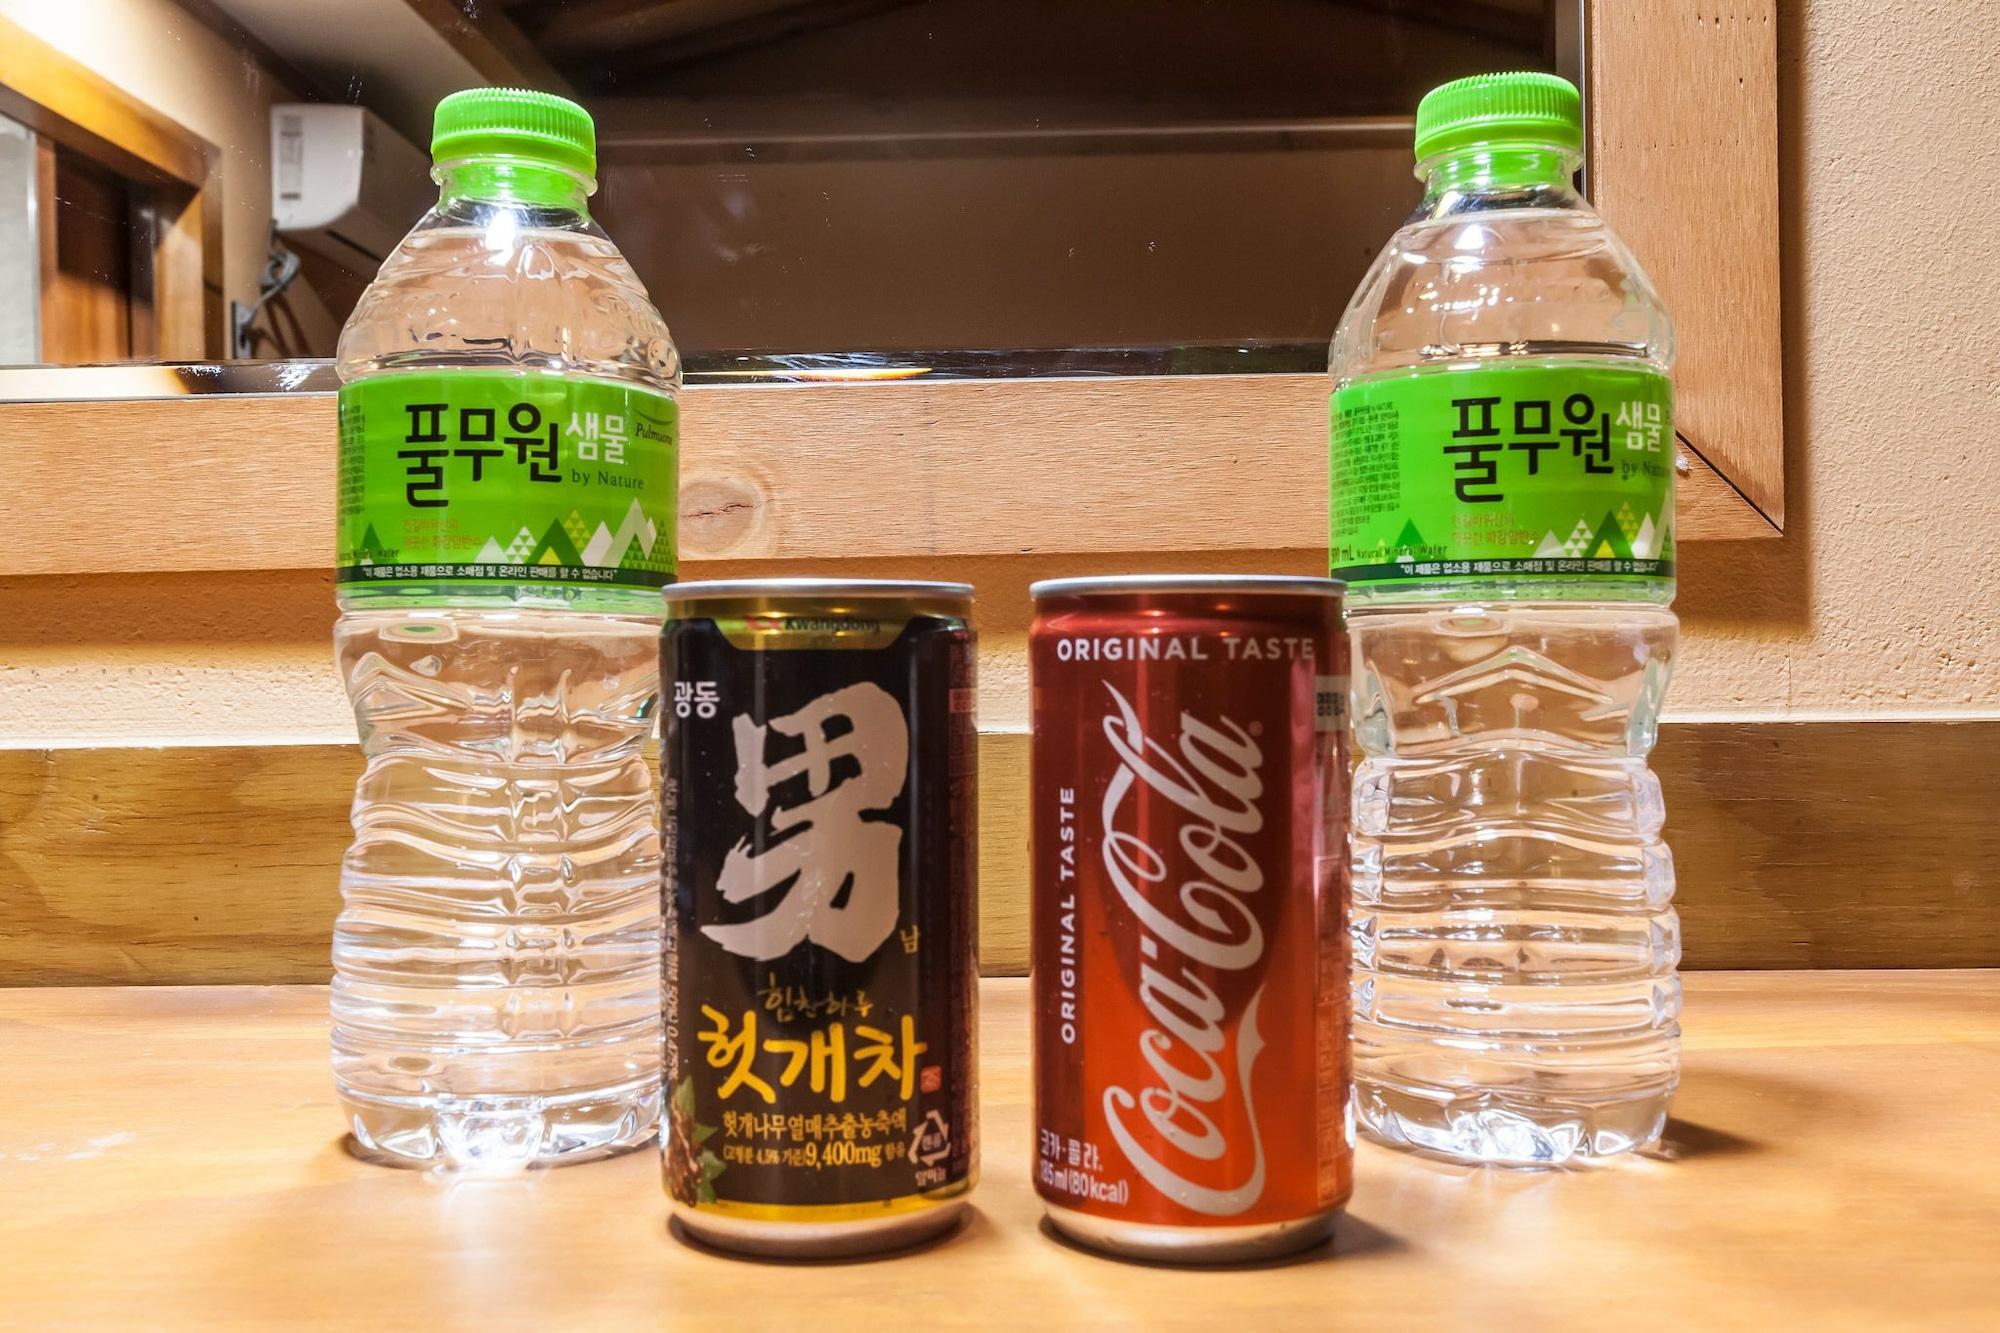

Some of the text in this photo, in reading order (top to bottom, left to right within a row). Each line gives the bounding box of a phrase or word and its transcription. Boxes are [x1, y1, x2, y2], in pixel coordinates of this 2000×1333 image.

[398, 402, 562, 508] 풀무원
[565, 412, 629, 465] 샘물
[571, 468, 644, 490] by Nature
[1443, 393, 1614, 503] 풀무원
[1615, 401, 1663, 453] 샘물
[395, 565, 418, 578] 업소용
[420, 565, 454, 577] 제품으로
[456, 565, 484, 577] 소매점
[486, 565, 496, 577] 및
[498, 565, 527, 578] 온라인
[571, 568, 580, 579] 수
[1415, 562, 1441, 575] 제품은
[1443, 561, 1471, 574] 업소용
[1473, 560, 1513, 573] 제품으로
[1515, 560, 1543, 573] 소매점
[1558, 560, 1584, 572] 온라인
[1623, 560, 1633, 572] 수
[1420, 544, 1448, 555] Water
[1056, 637, 1315, 662] ORIGINAL TASTE
[673, 680, 720, 719] 광동
[700, 681, 909, 963] 男
[1059, 787, 1077, 1045] ORIGINAL TASTE
[1102, 679, 1265, 1217] Coca-Cola
[697, 1003, 928, 1105] 헛개차
